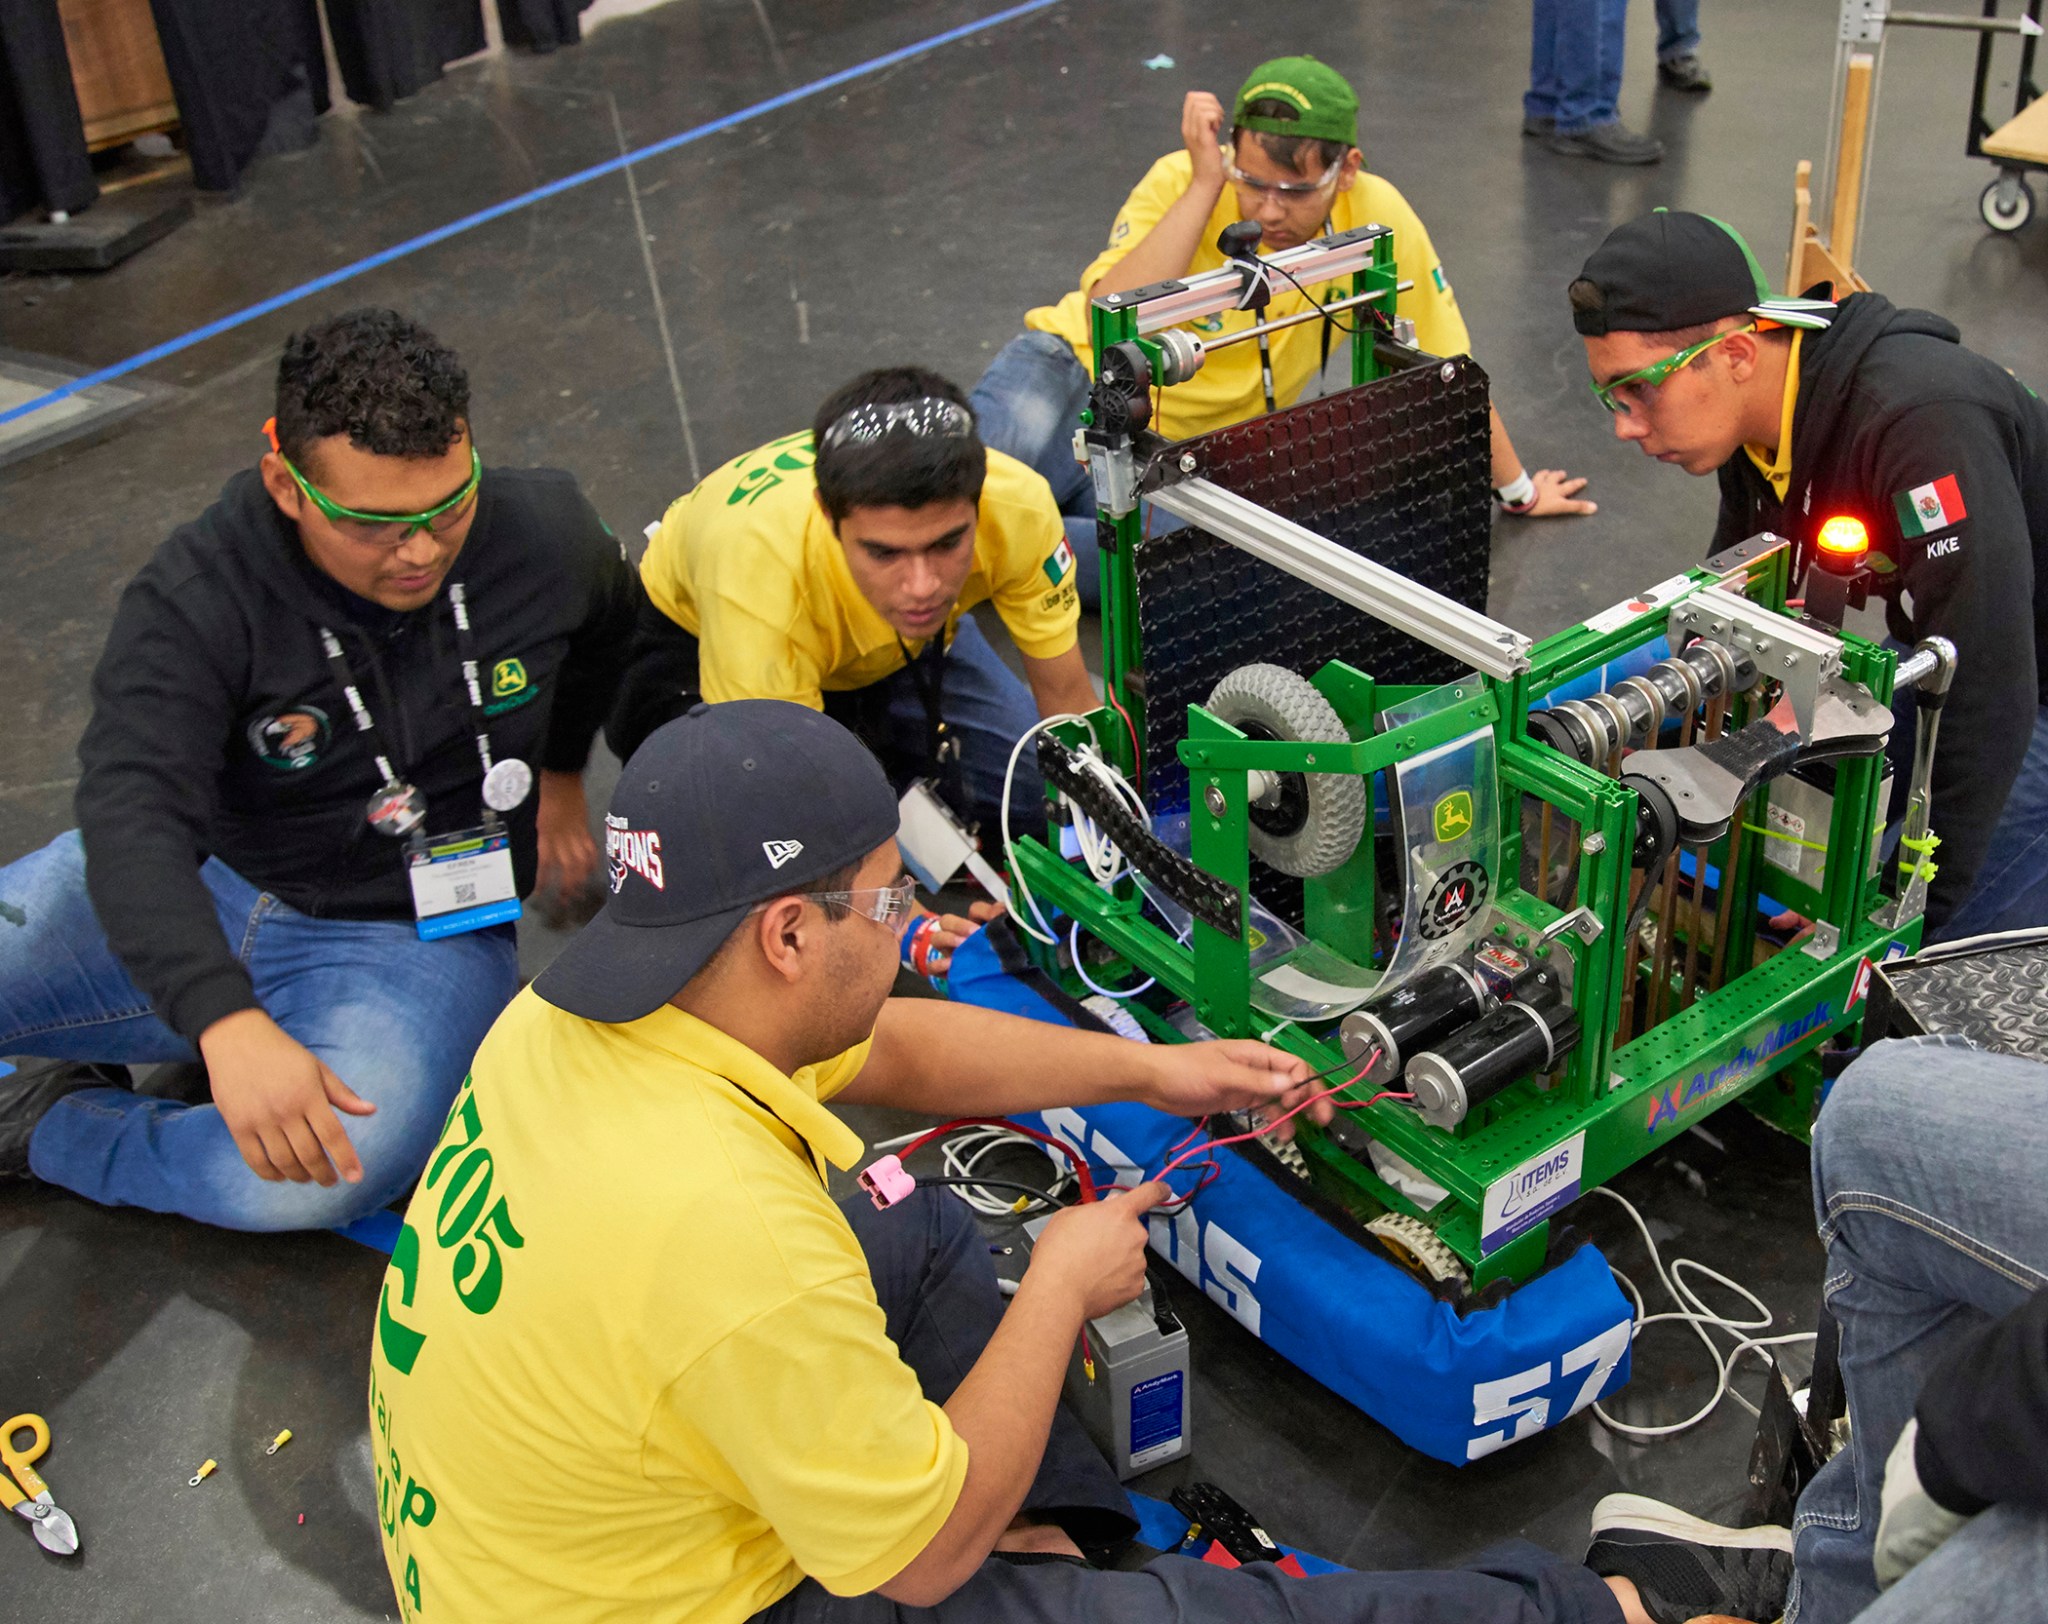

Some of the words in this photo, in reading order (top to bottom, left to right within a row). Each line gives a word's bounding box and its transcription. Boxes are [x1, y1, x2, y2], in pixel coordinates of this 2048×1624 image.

[1926, 536, 1960, 559] KIKE
[605, 826, 666, 892] PIONS
[1682, 1000, 1831, 1106] AndyMark
[426, 1072, 526, 1316] 705
[1520, 1149, 1570, 1194] ITEMS
[1466, 1318, 1633, 1461] 57
